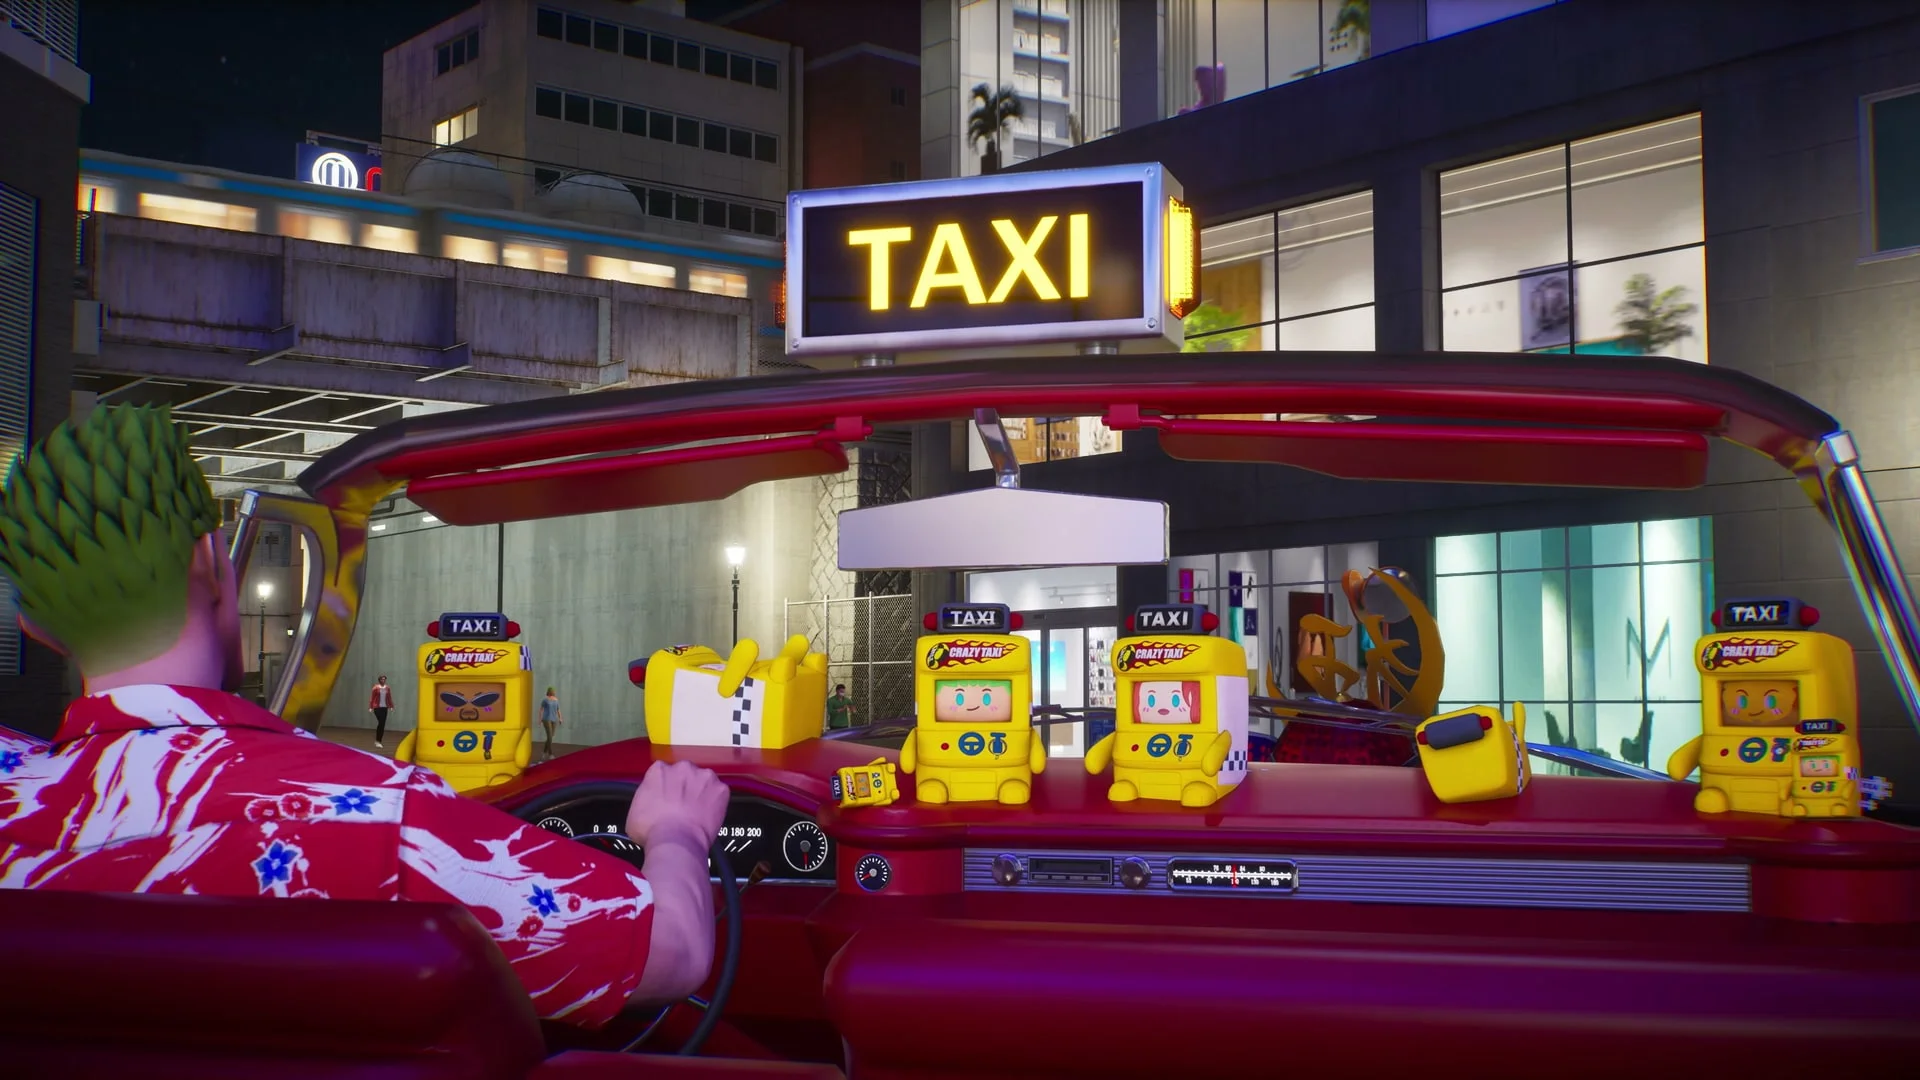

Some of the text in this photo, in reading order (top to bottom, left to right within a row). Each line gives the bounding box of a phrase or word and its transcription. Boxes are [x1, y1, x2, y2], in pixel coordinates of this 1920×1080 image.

[848, 213, 1089, 310] TAXI
[950, 610, 996, 625] TAXI
[1140, 611, 1189, 627] TAXI
[1732, 604, 1779, 622] TAXI
[450, 619, 492, 633] TAXI
[444, 652, 475, 663] CRAZY
[474, 652, 495, 663] TAXI
[949, 647, 981, 658] CRAZY
[980, 647, 1003, 658] TAXI
[1135, 648, 1164, 660] CRAZY
[1163, 648, 1184, 659] TAXI
[1722, 645, 1755, 657] CRAZY
[1755, 645, 1779, 657] TAXI
[1805, 722, 1828, 731] TAXI
[593, 824, 600, 834] 0
[607, 824, 618, 834] 20
[731, 827, 745, 837] 180
[746, 827, 762, 837] 200
